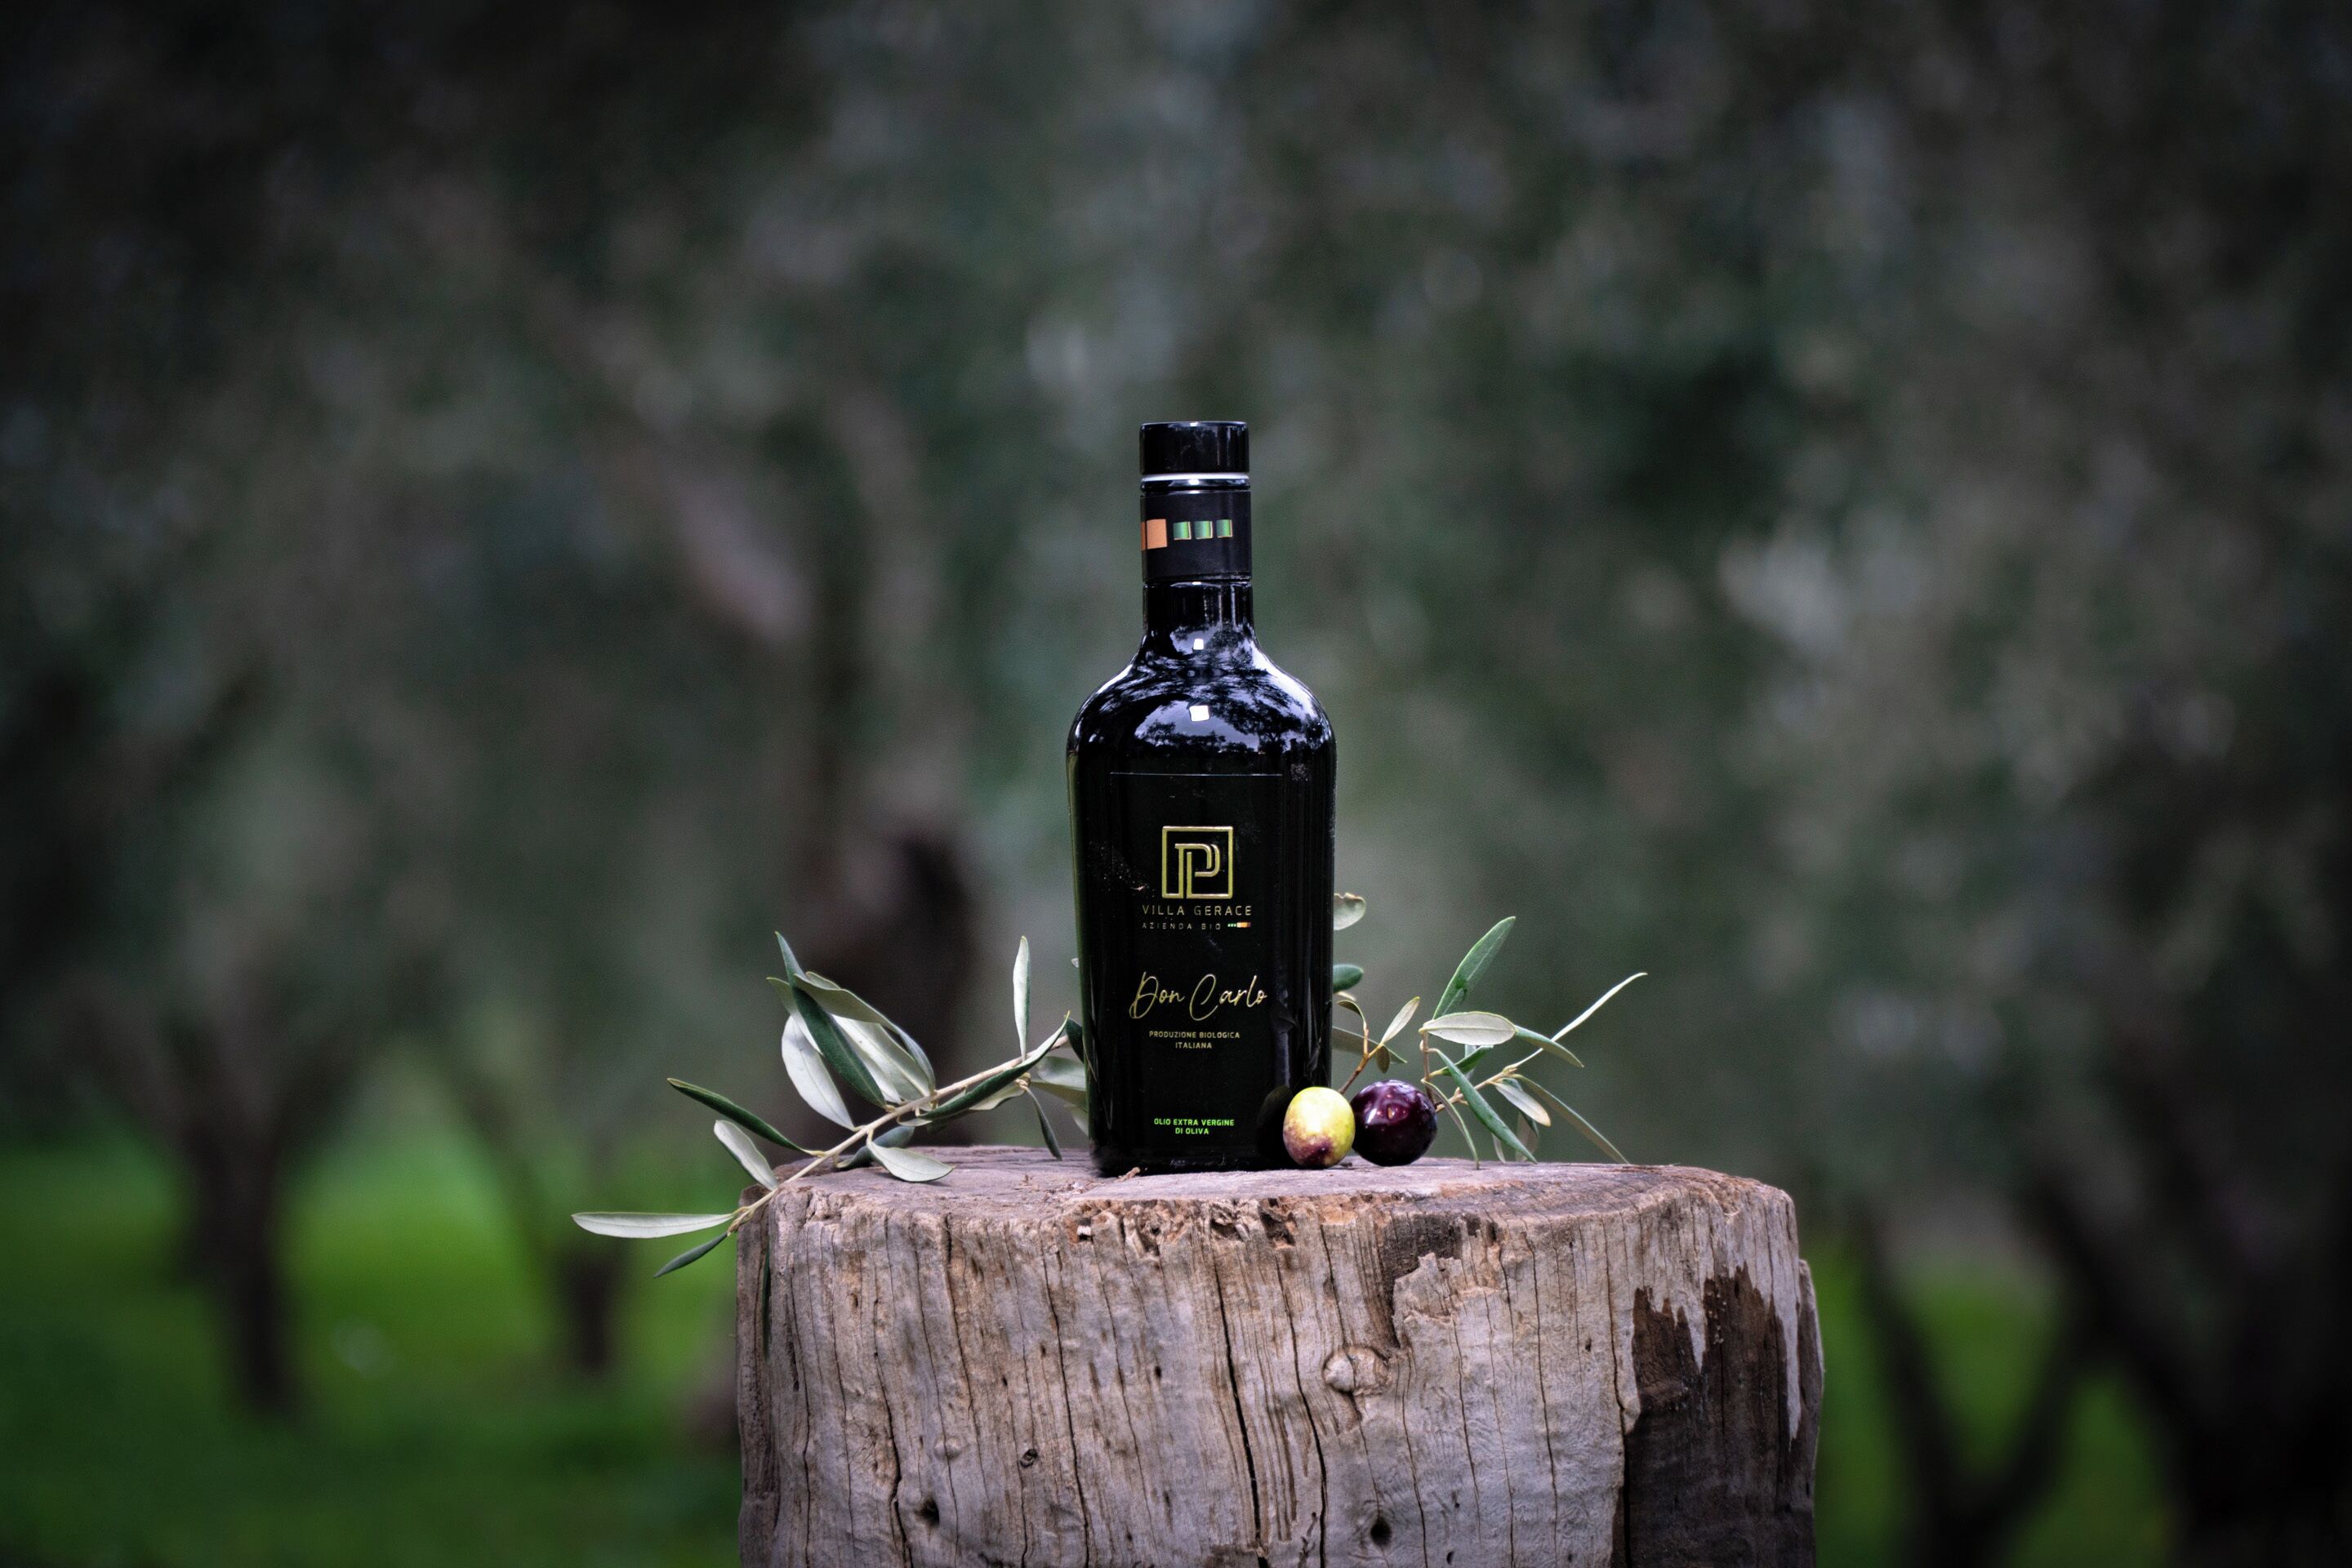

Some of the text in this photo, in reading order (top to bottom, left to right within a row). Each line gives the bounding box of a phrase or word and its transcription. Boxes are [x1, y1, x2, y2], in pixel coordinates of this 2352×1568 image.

[1142, 905, 1252, 915] VILLA GERACE
[1143, 922, 1192, 930] AZIENDA
[1129, 971, 1267, 1021] Don Carlo
